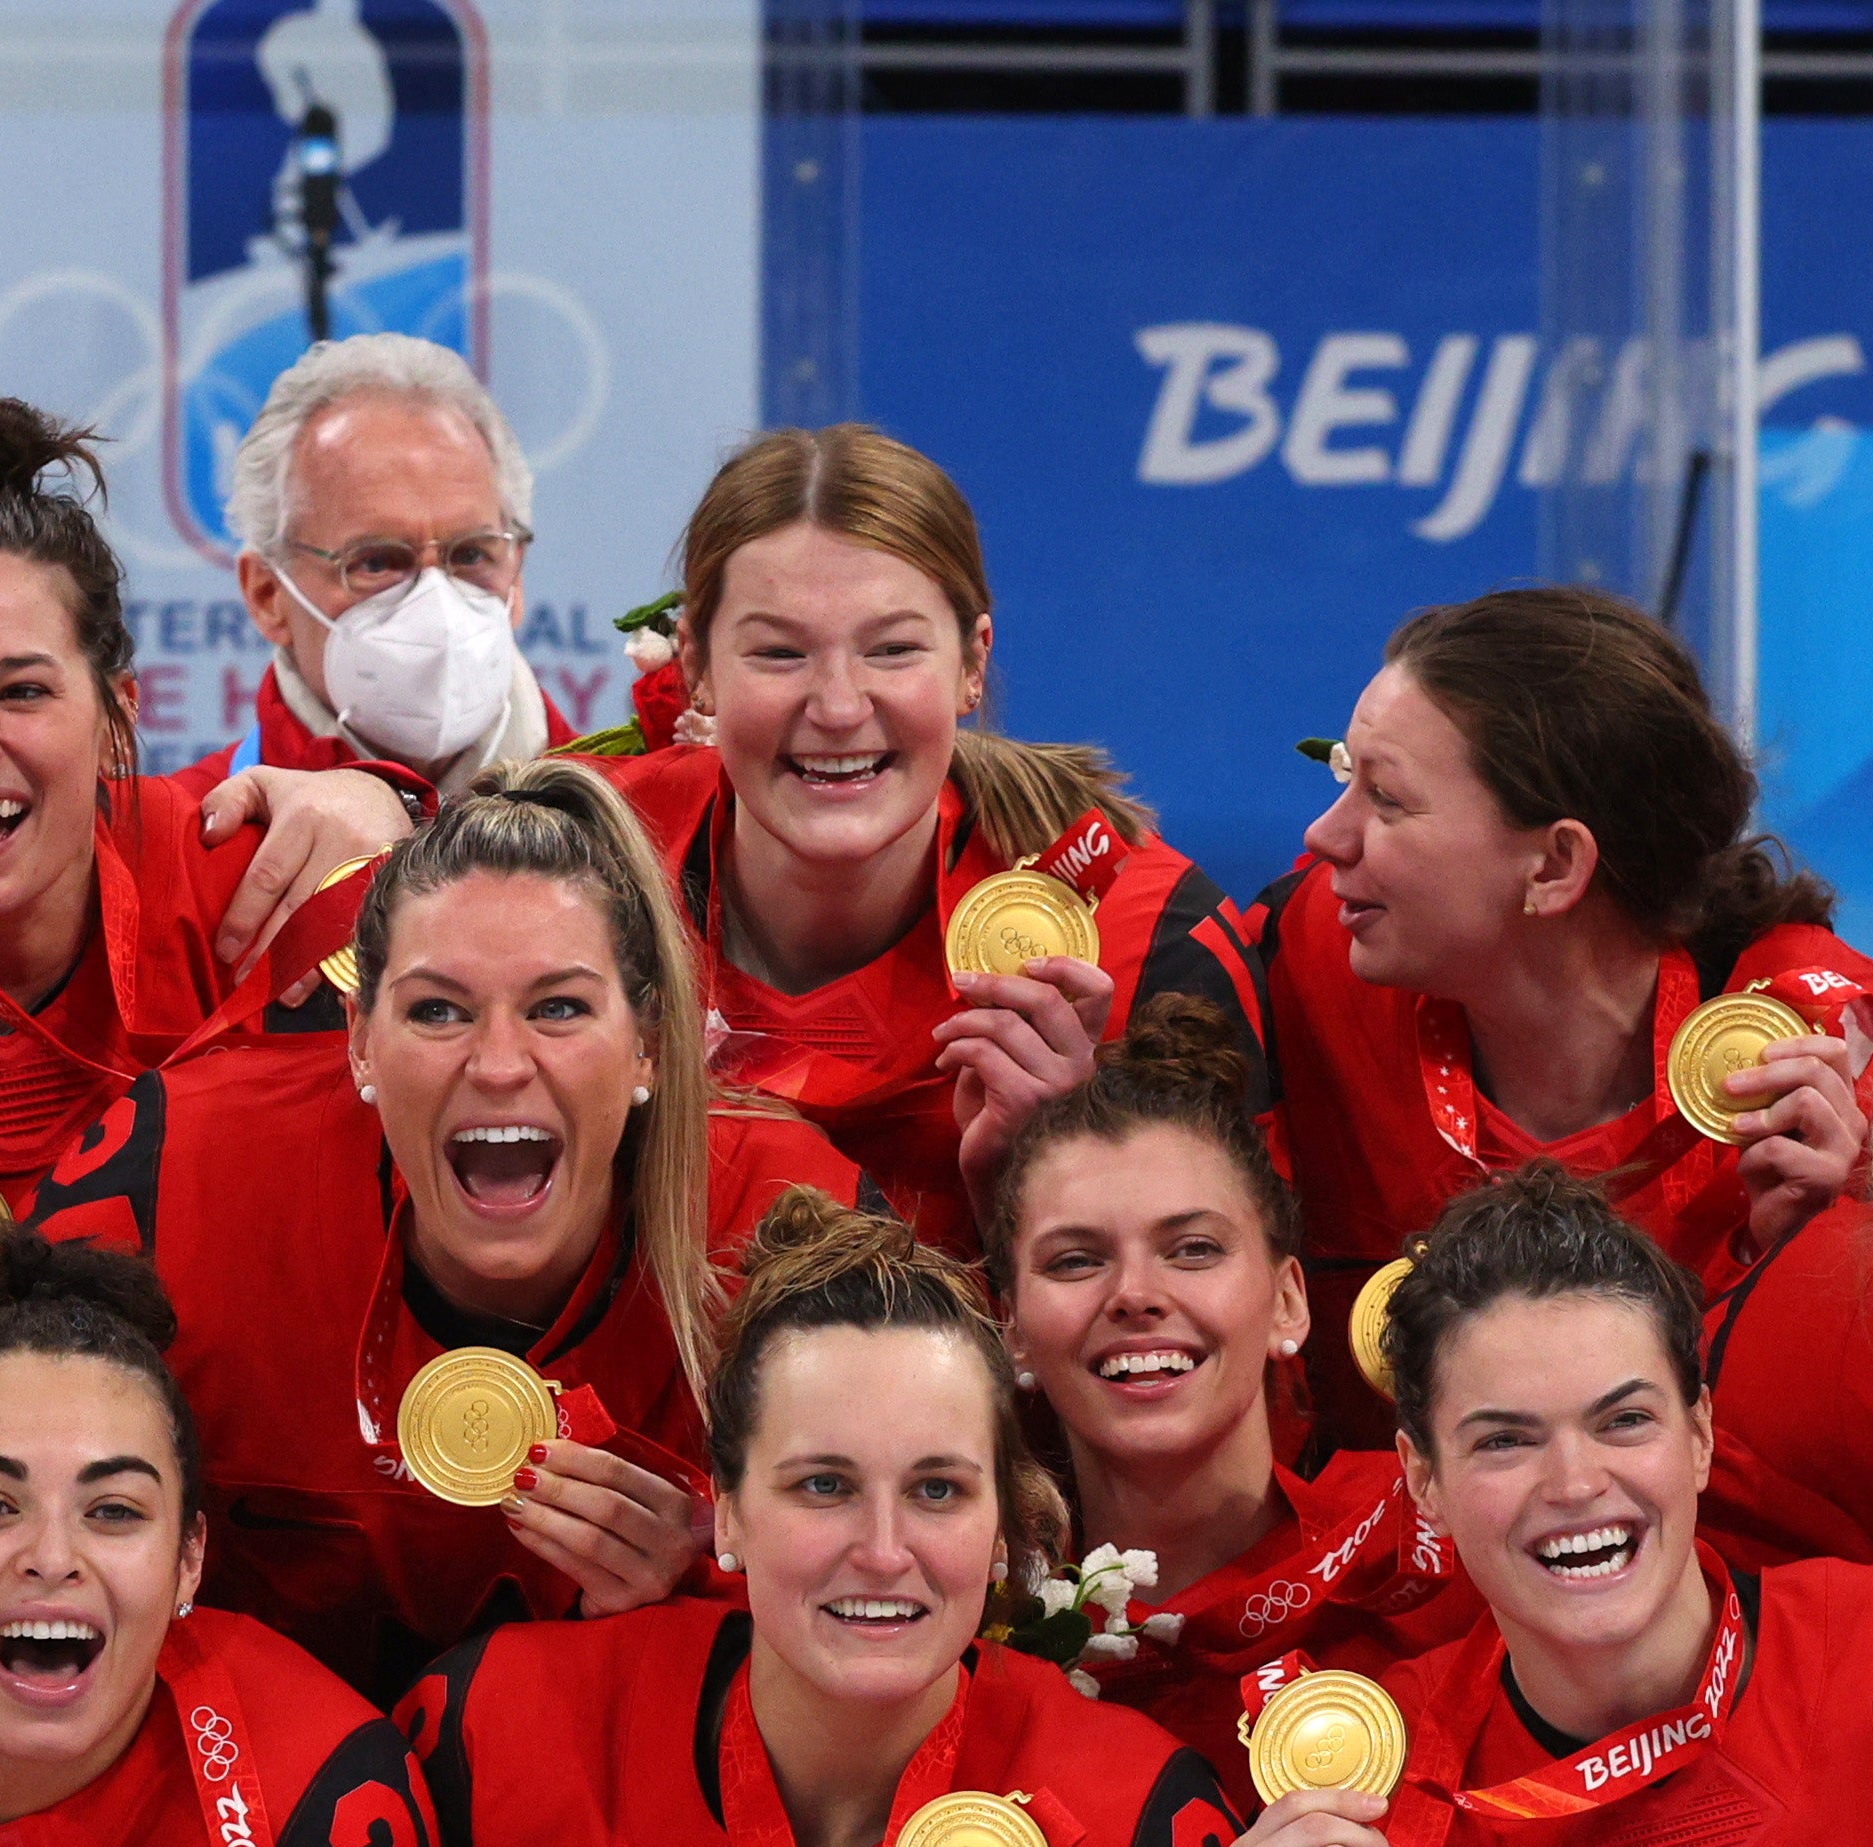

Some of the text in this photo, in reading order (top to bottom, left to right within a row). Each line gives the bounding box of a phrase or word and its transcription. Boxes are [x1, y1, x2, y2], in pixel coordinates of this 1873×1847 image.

[1306, 1499, 1386, 1583] 2022
[1574, 1626, 1737, 1792] BEIJING 2022
